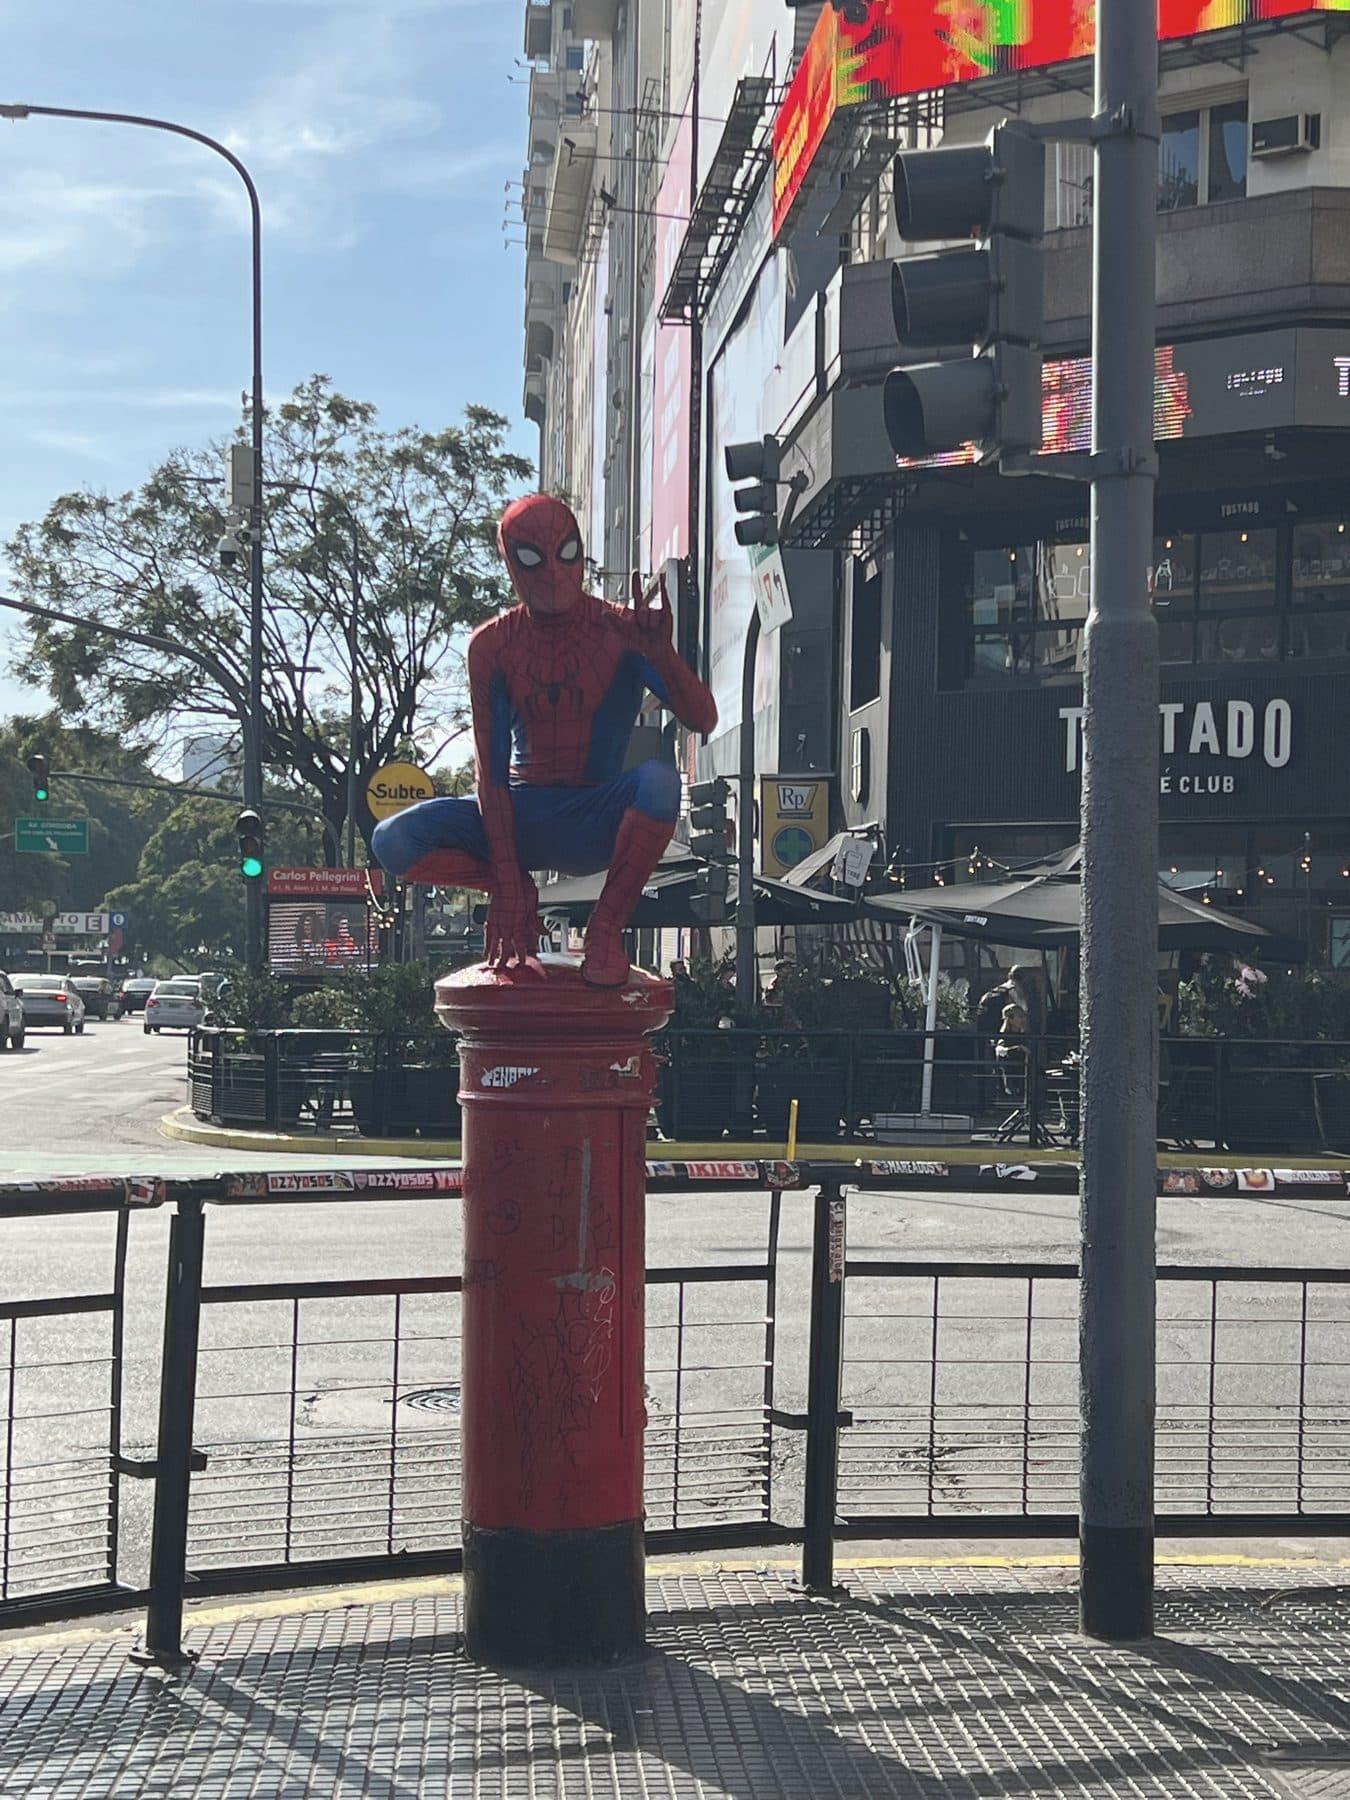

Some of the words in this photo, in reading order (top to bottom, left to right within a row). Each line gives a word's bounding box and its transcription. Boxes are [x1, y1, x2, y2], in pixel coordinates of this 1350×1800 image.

[1059, 698, 1292, 773] TTADO
[376, 783, 426, 799] Subte
[1179, 775, 1235, 793] CLUB
[273, 871, 306, 881] Carlos
[309, 871, 360, 883] Pellegrini
[368, 1172, 433, 1187] OZZYOSOS
